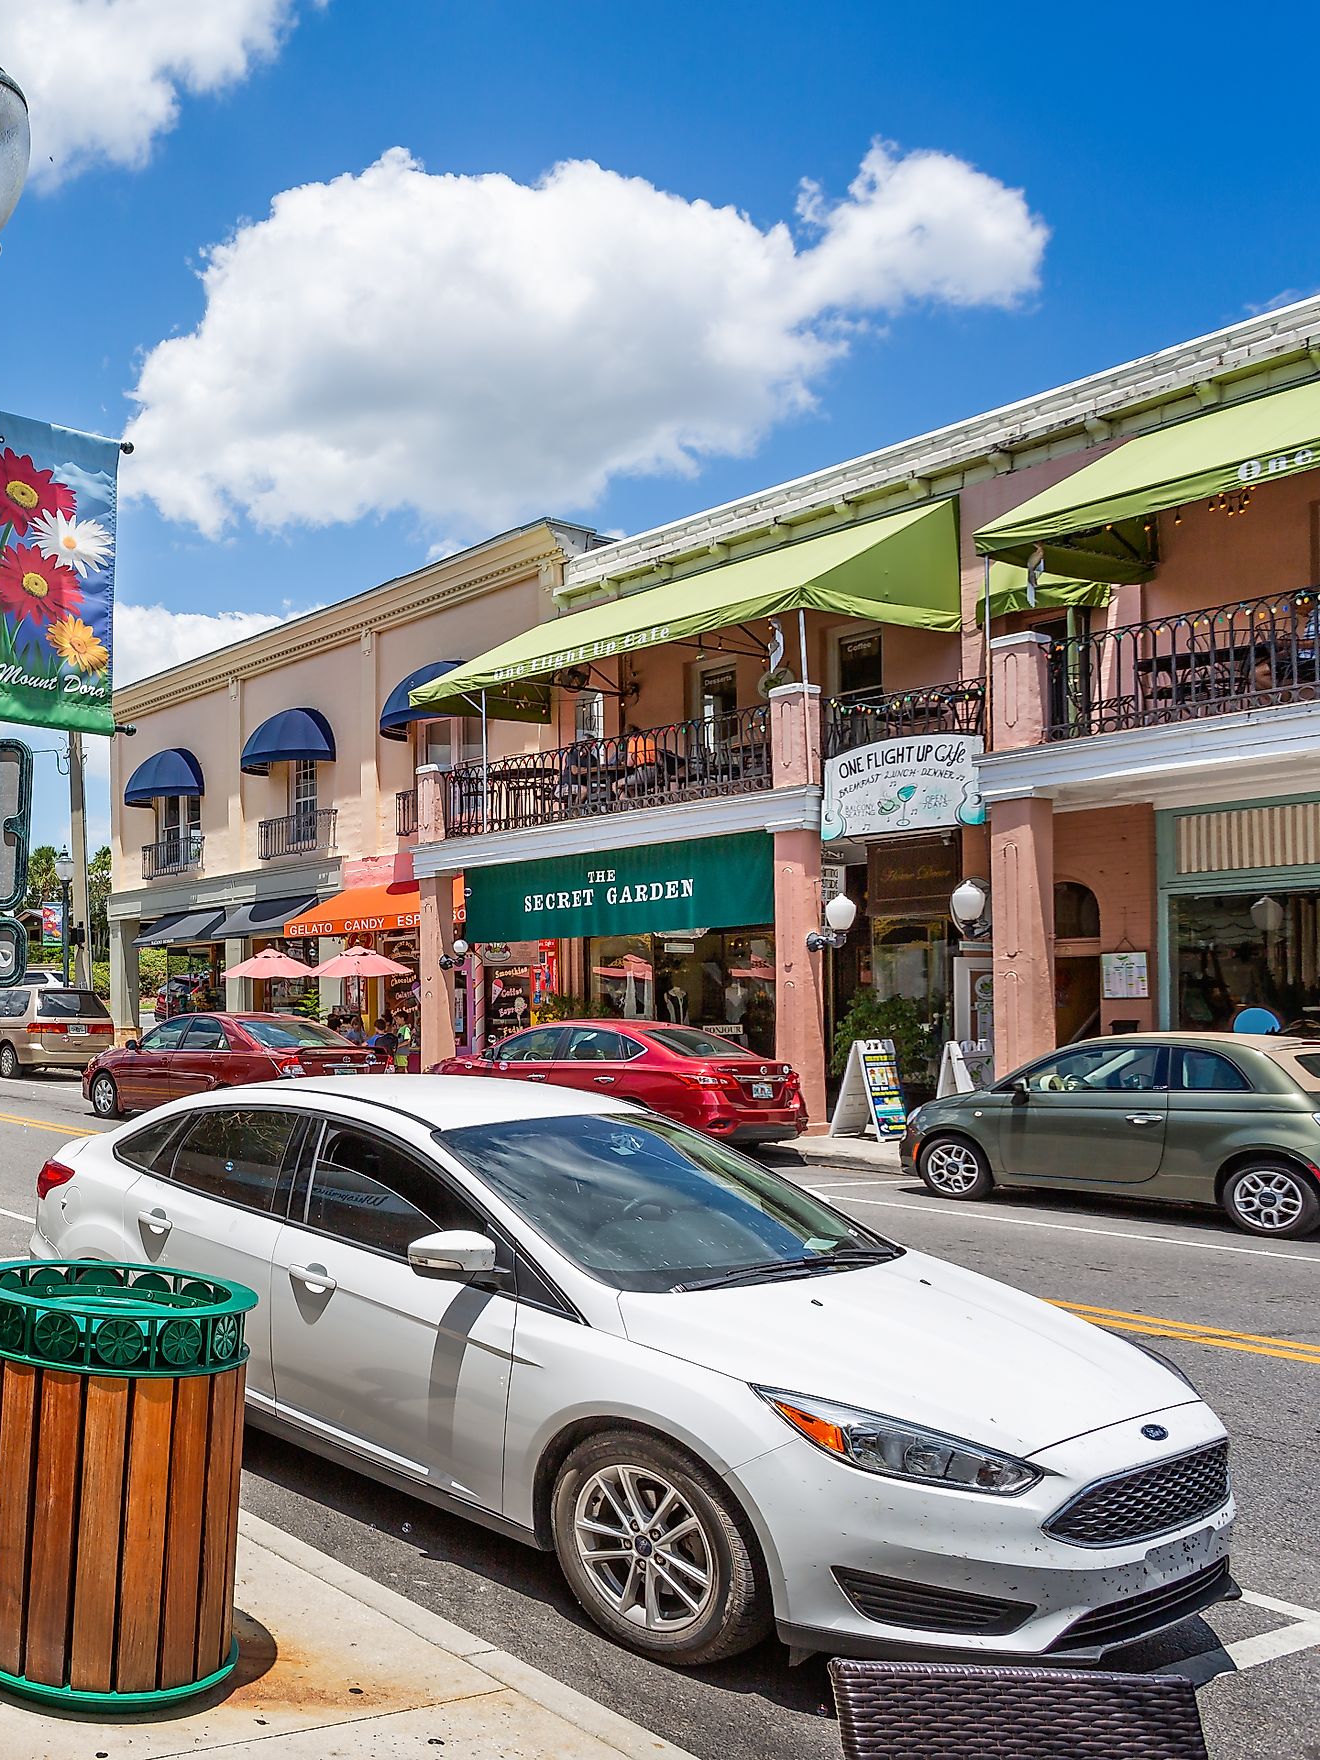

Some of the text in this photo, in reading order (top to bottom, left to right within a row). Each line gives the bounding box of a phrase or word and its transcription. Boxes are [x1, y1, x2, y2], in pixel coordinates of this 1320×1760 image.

[1238, 449, 1313, 481] One
[847, 641, 872, 653] Coffee
[531, 648, 585, 671] Flight
[593, 641, 616, 656] Up
[63, 674, 106, 698] Dora
[704, 674, 733, 687] Desserts
[838, 759, 865, 778] ONE
[867, 746, 915, 769] FLIGHT
[916, 745, 933, 762] UP
[838, 773, 883, 799] BREAKFAST
[921, 768, 955, 780] DINNER
[925, 794, 947, 802] OPEN
[845, 810, 876, 818] SEATING
[587, 870, 616, 883] THE
[524, 879, 693, 912] SECRET GARDEN
[289, 922, 333, 936] GELATO
[344, 918, 384, 931] CANDY
[495, 967, 528, 978] Smoothies
[501, 987, 523, 998] Coffee
[704, 1025, 742, 1034] BONJOUR
